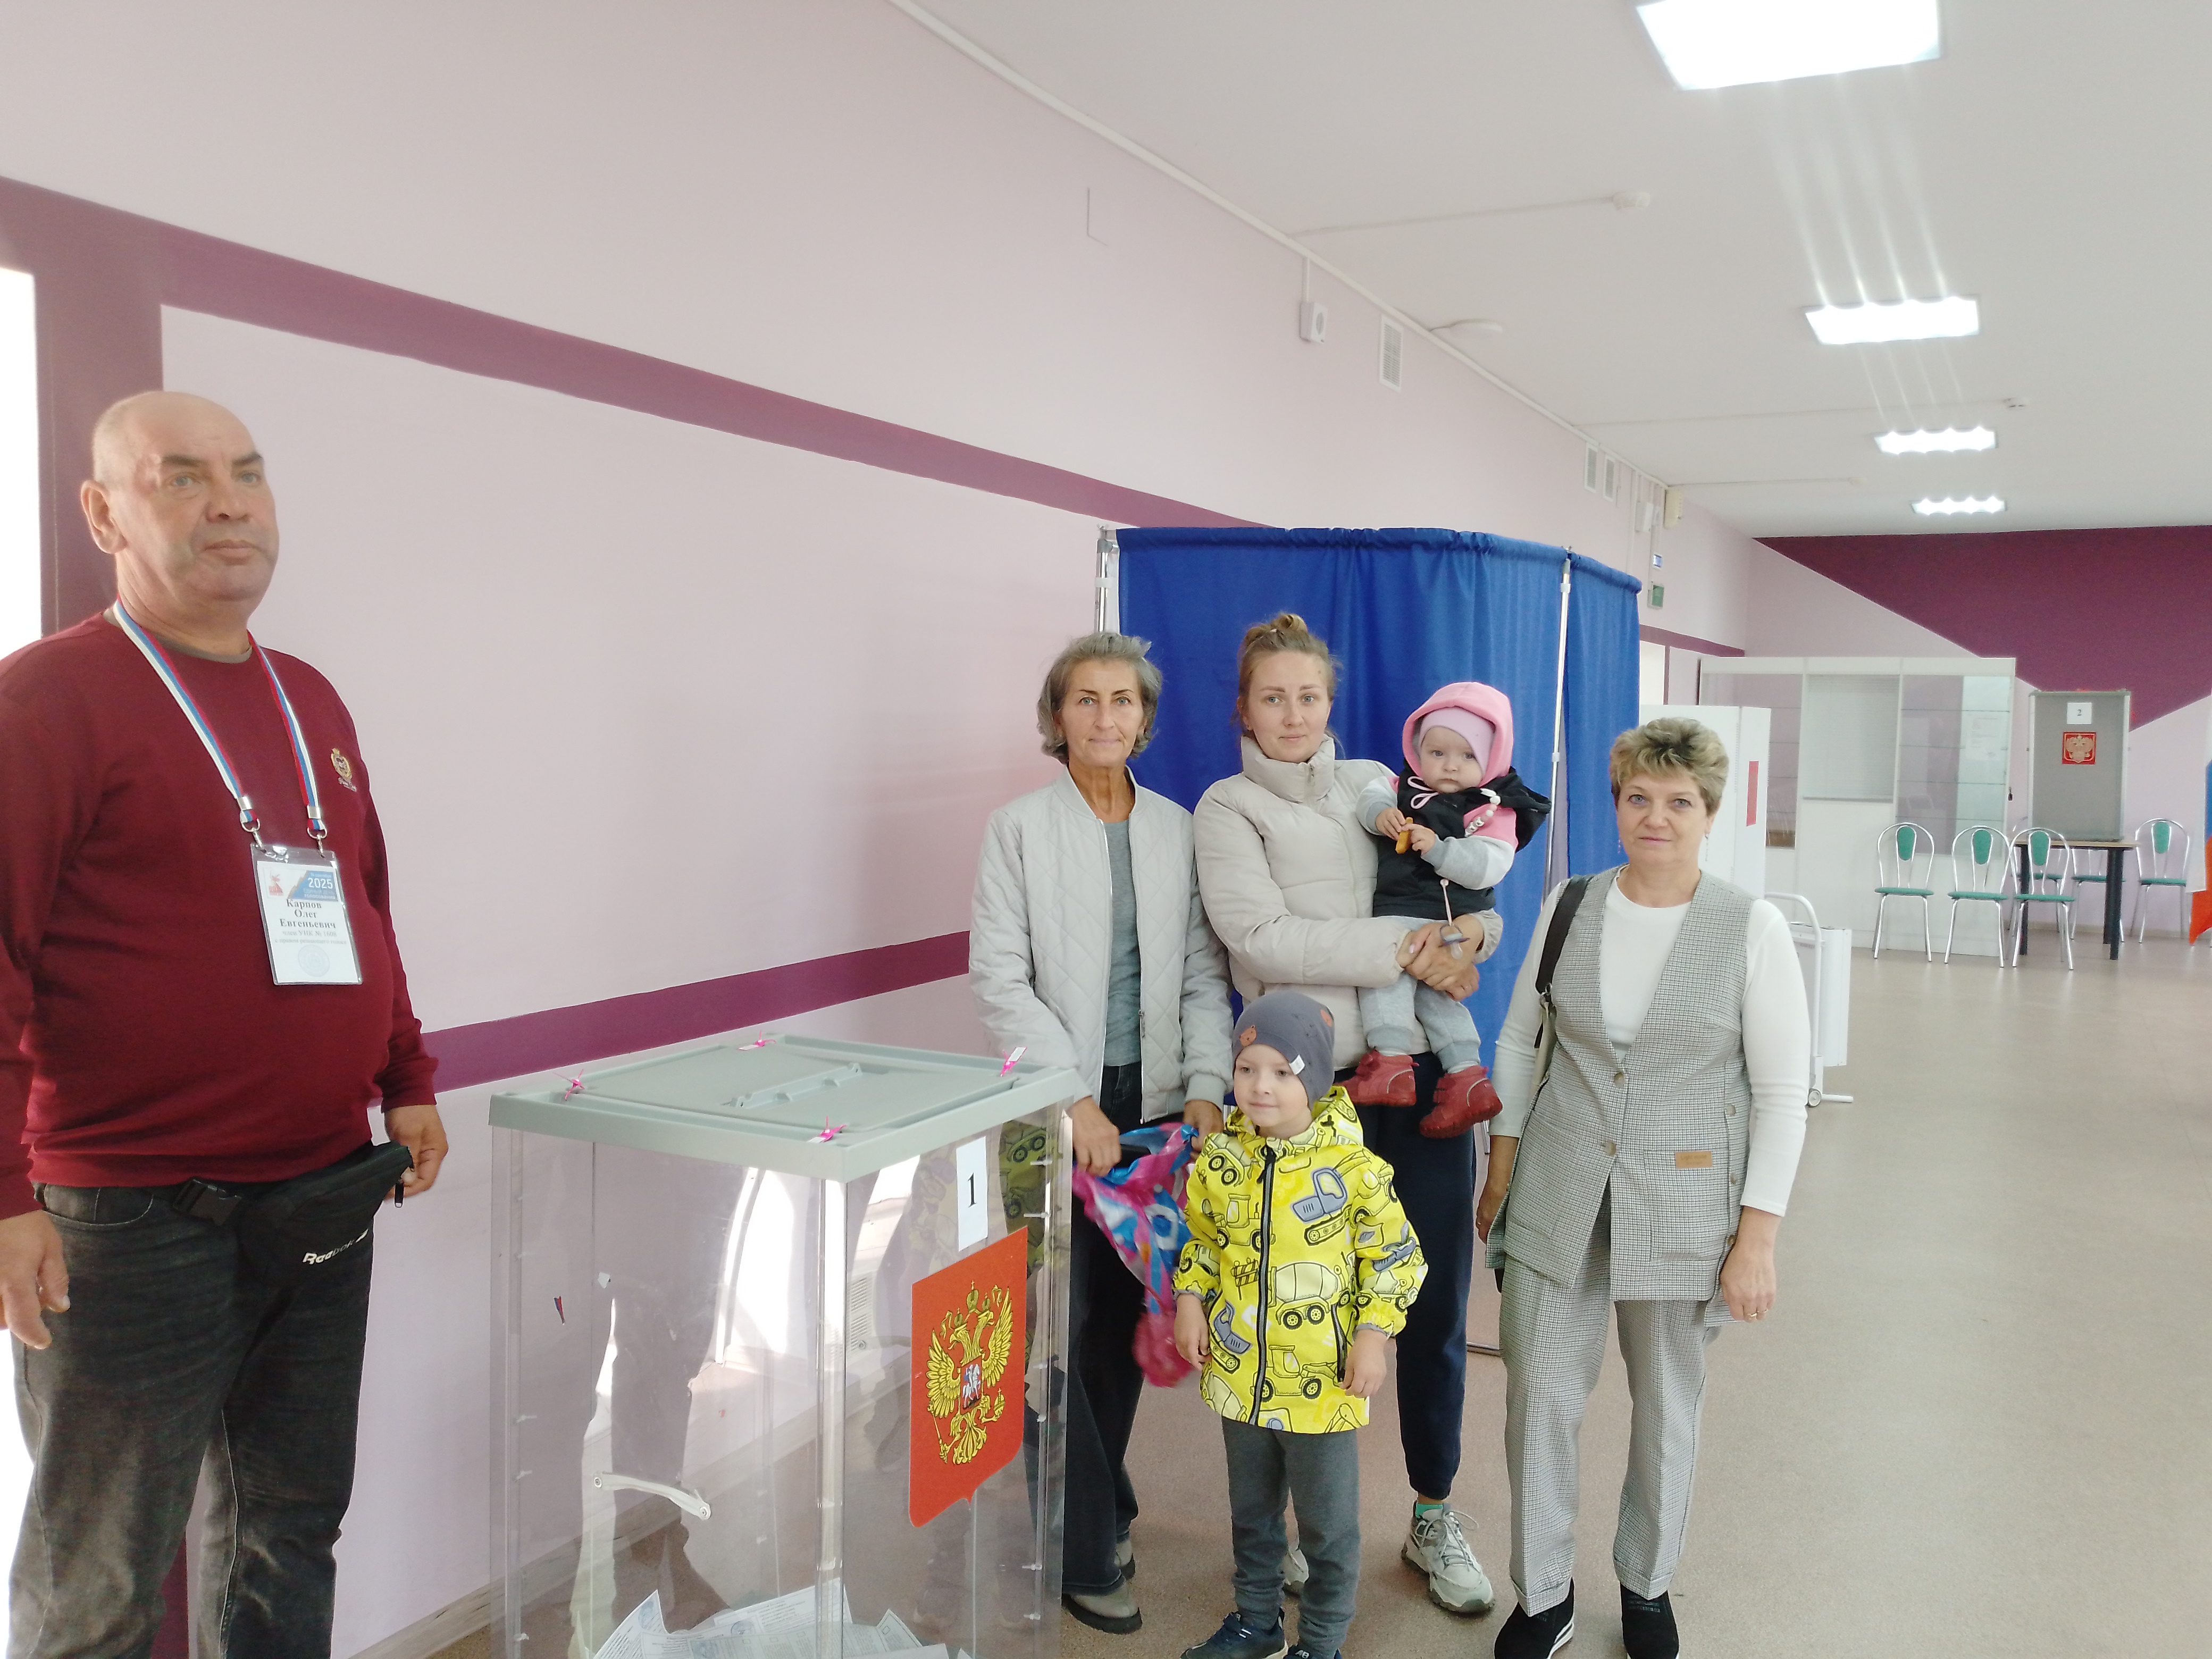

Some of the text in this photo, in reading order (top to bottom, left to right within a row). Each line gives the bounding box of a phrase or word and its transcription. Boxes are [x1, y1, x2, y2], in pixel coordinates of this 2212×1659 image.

[307, 877, 333, 890] 2025
[286, 899, 322, 910] Карпов
[294, 909, 317, 918] Олег
[279, 918, 336, 928] Евгеньевич
[967, 1172, 977, 1208] 1
